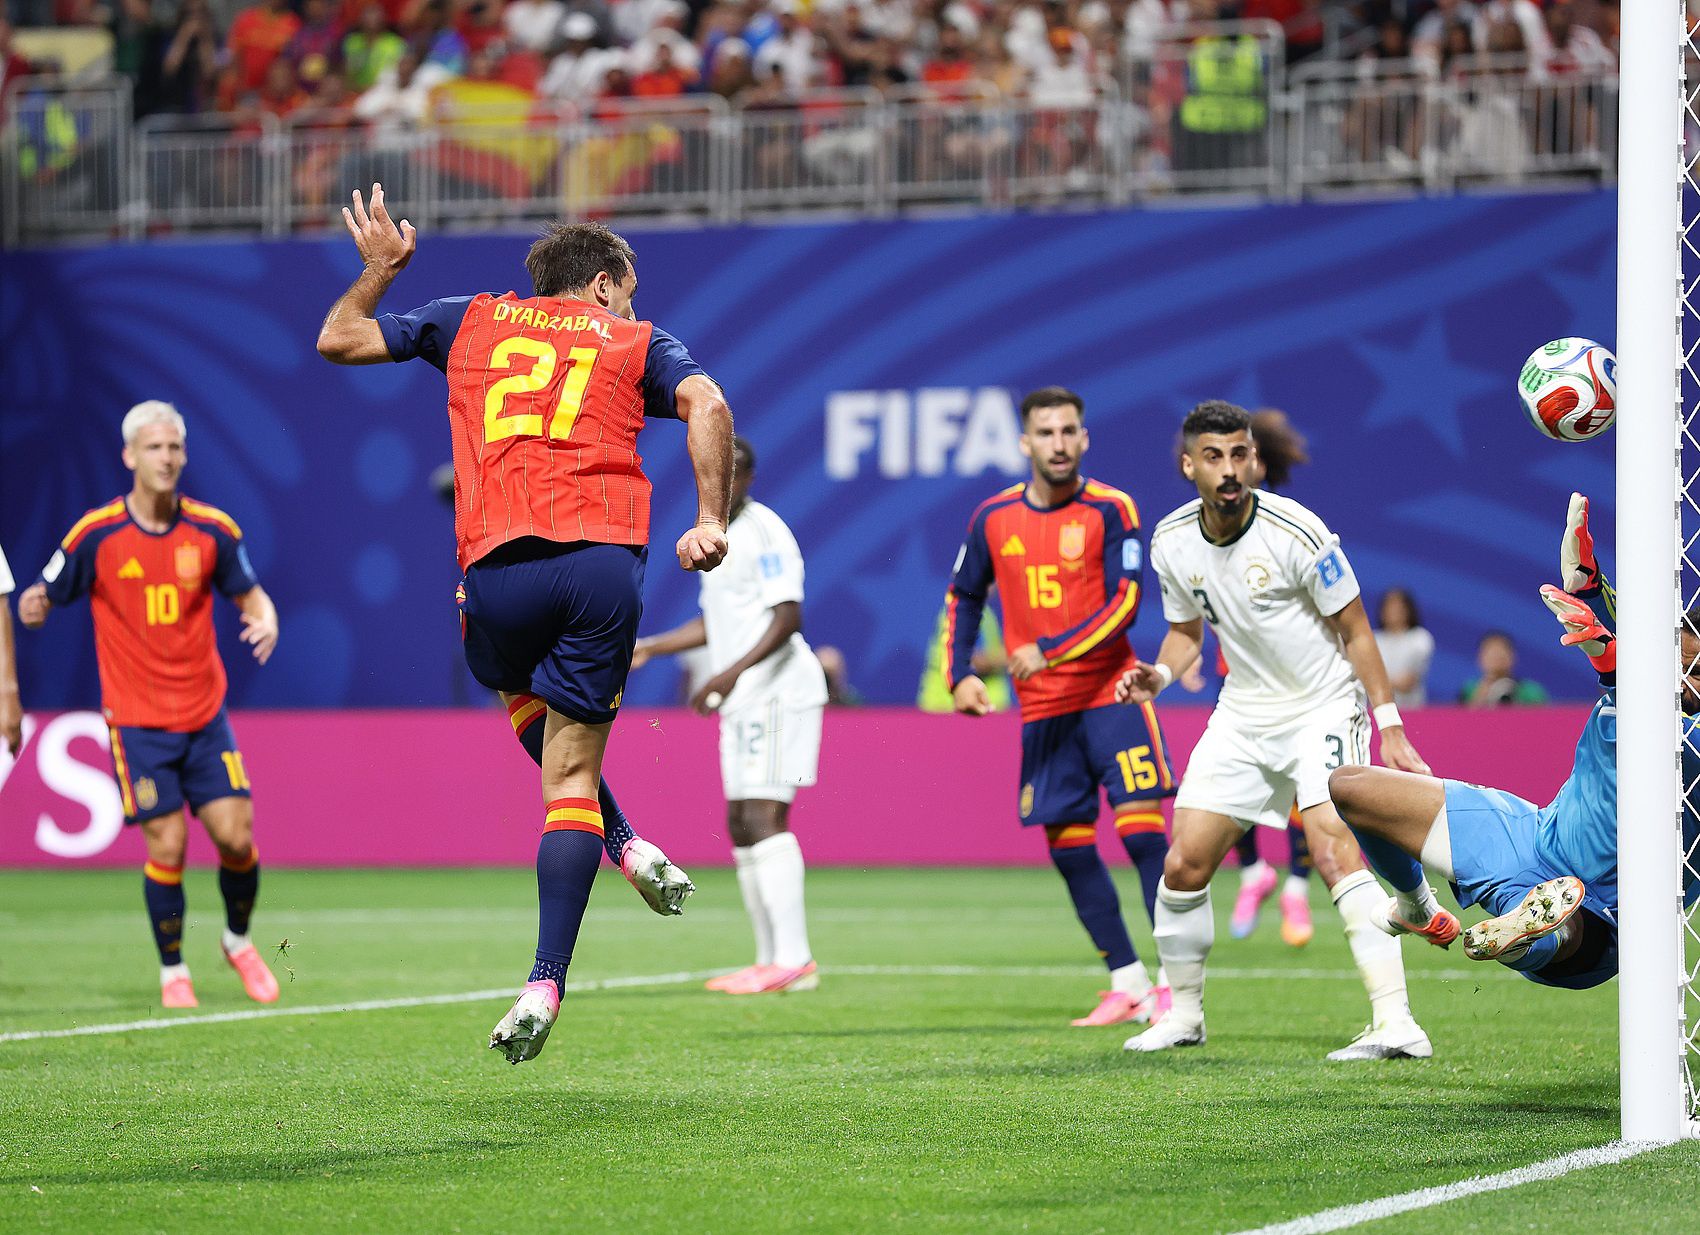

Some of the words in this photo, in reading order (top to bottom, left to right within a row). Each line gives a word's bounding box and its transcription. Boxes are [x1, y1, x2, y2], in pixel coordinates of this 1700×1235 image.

[493, 303, 613, 340] OYARZABAL
[484, 337, 599, 444] 21
[825, 386, 1028, 481] FIFA
[144, 583, 180, 626] 10
[1026, 565, 1062, 609] 15
[1193, 589, 1219, 625] 3
[737, 721, 765, 754] 12
[1325, 734, 1344, 770] 3
[1115, 745, 1159, 793] 15
